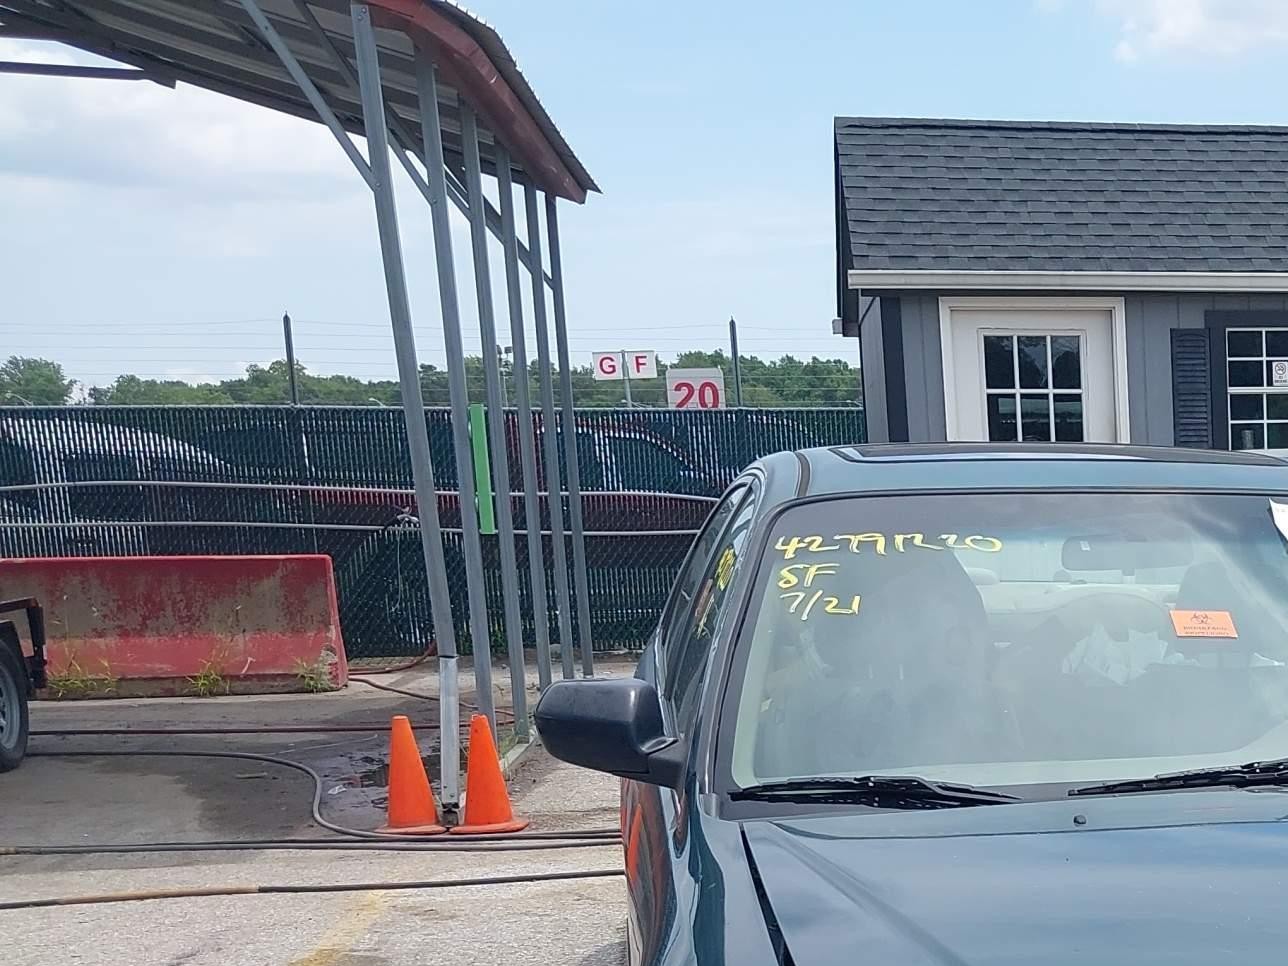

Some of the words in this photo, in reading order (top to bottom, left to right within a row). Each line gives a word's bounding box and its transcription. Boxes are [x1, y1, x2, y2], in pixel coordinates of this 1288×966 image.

[599, 357, 617, 375] G
[635, 356, 648, 374] F
[674, 382, 720, 409] 20
[779, 590, 862, 621] 7/21
